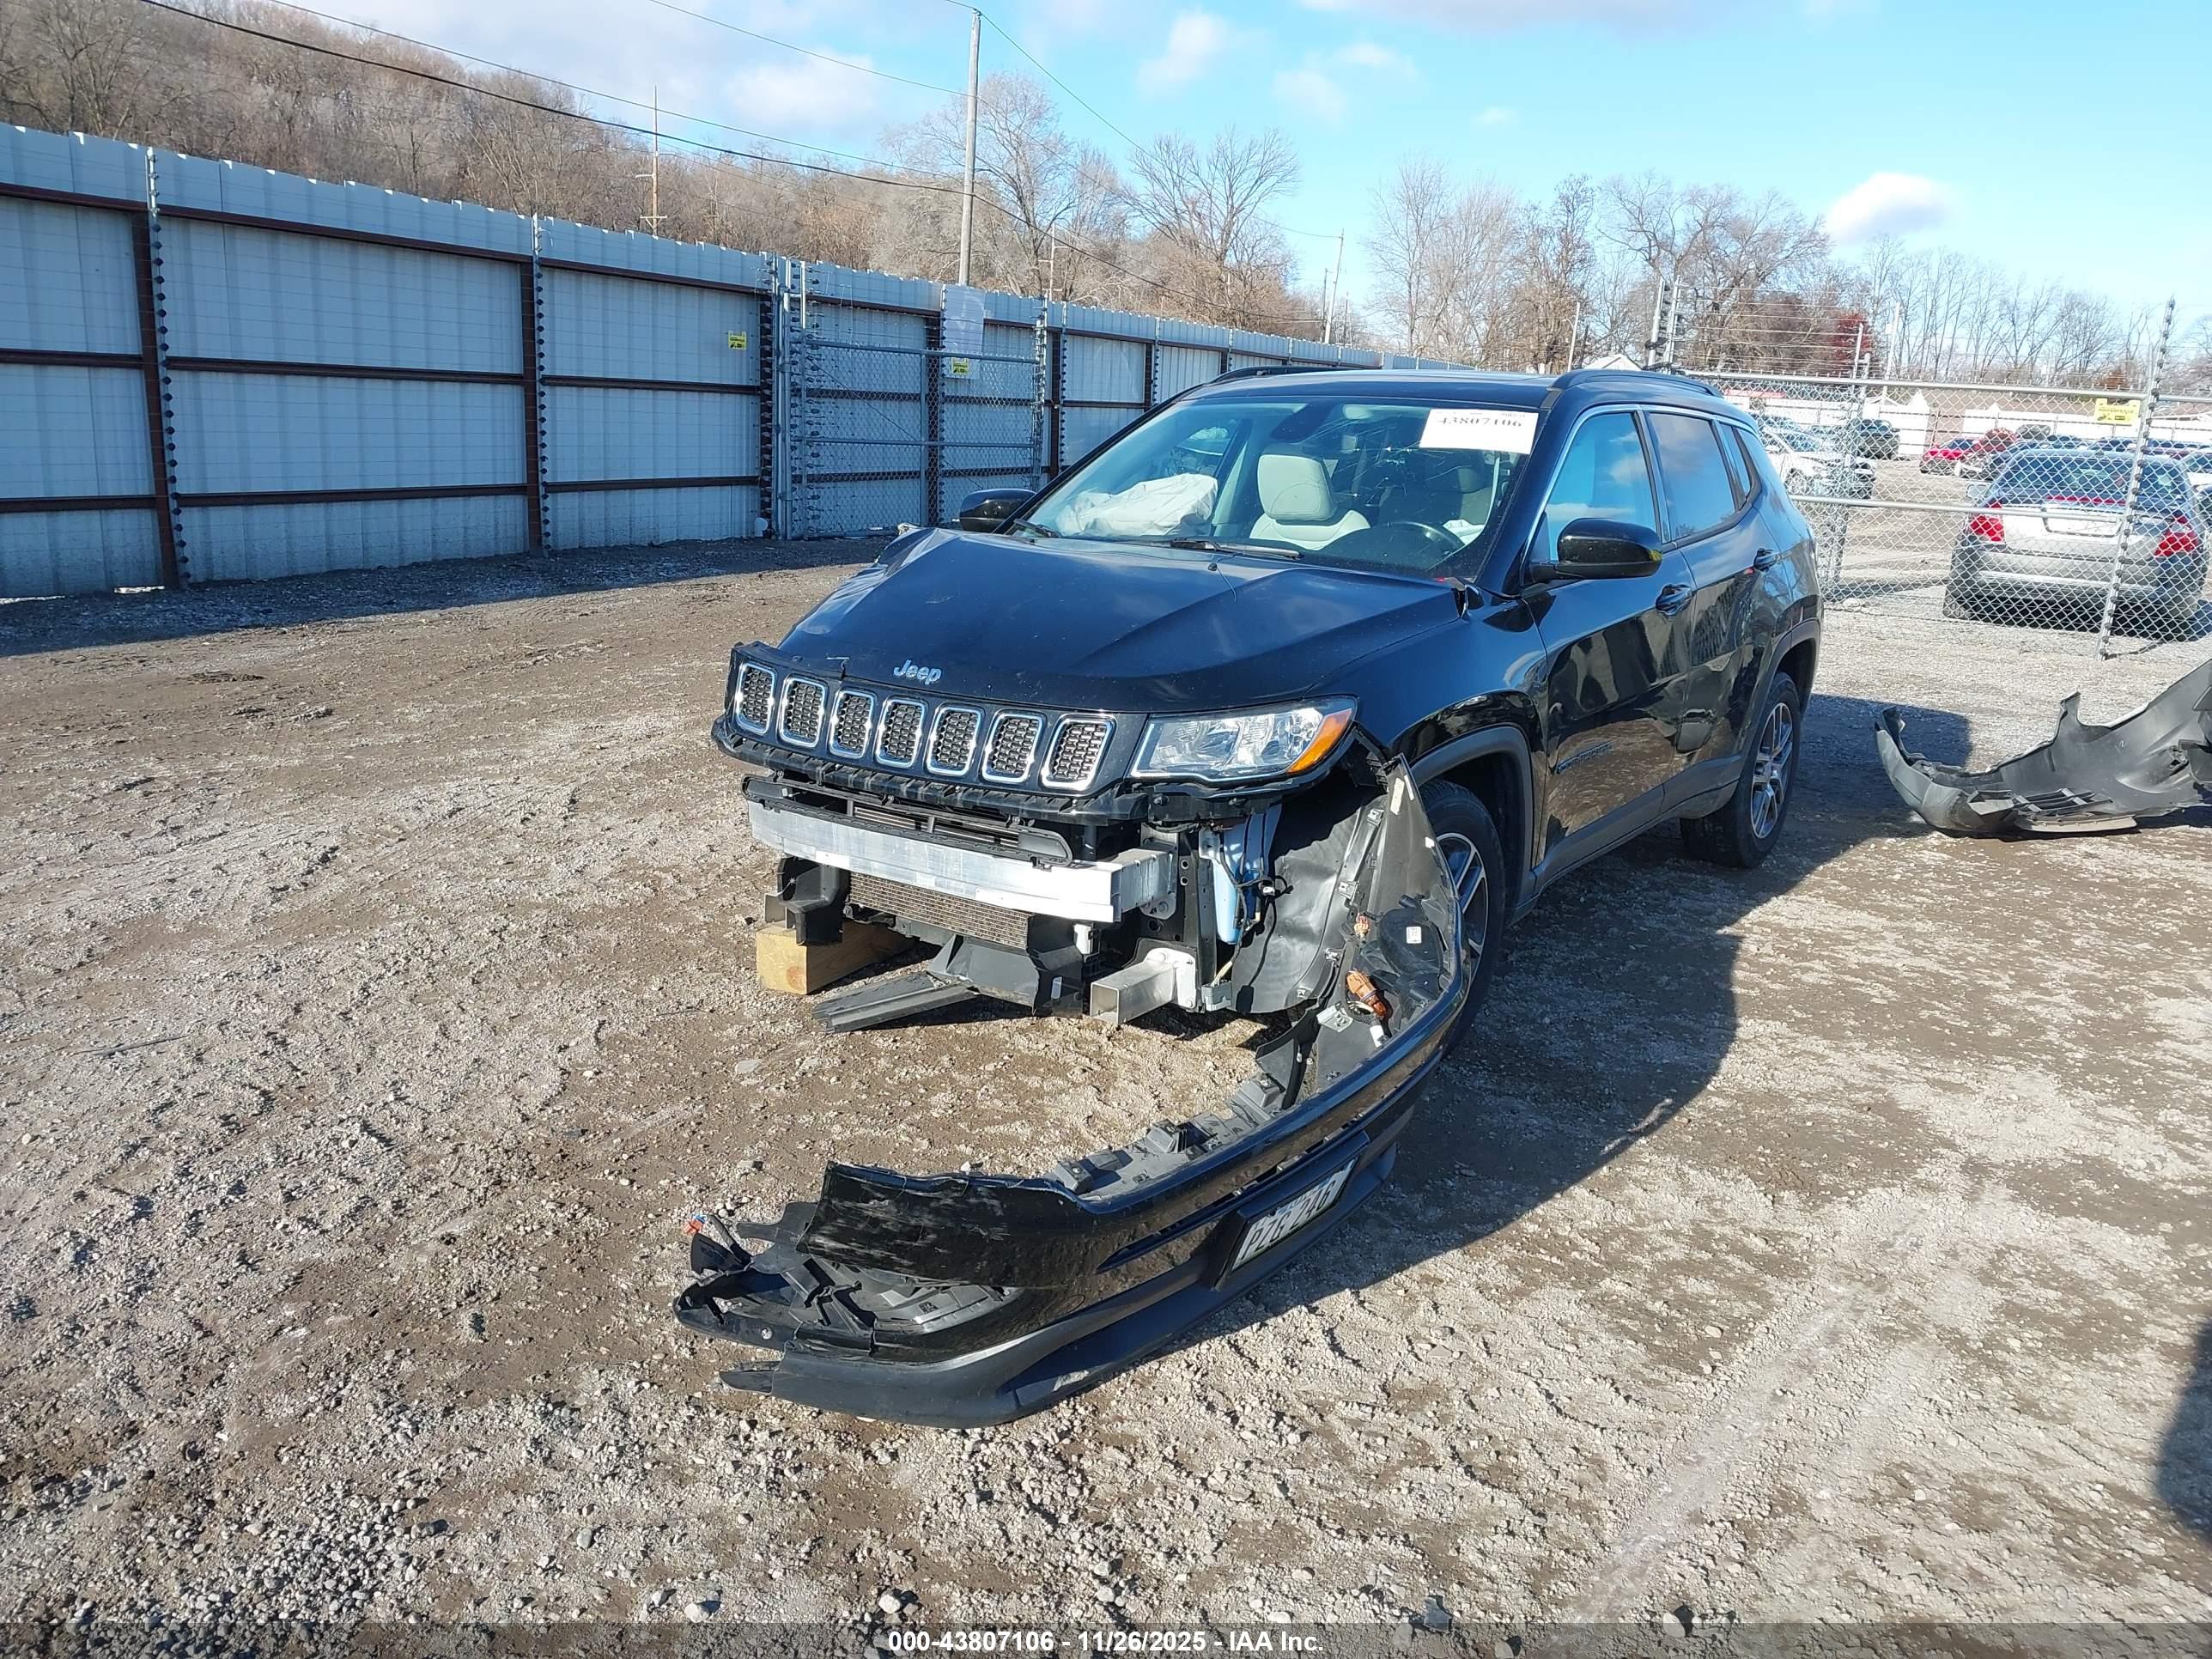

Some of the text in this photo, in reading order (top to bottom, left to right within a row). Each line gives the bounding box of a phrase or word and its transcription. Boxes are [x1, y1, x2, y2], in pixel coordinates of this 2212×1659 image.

[893, 659, 942, 685] Jeep
[1240, 1179, 1336, 1261] PZG 246
